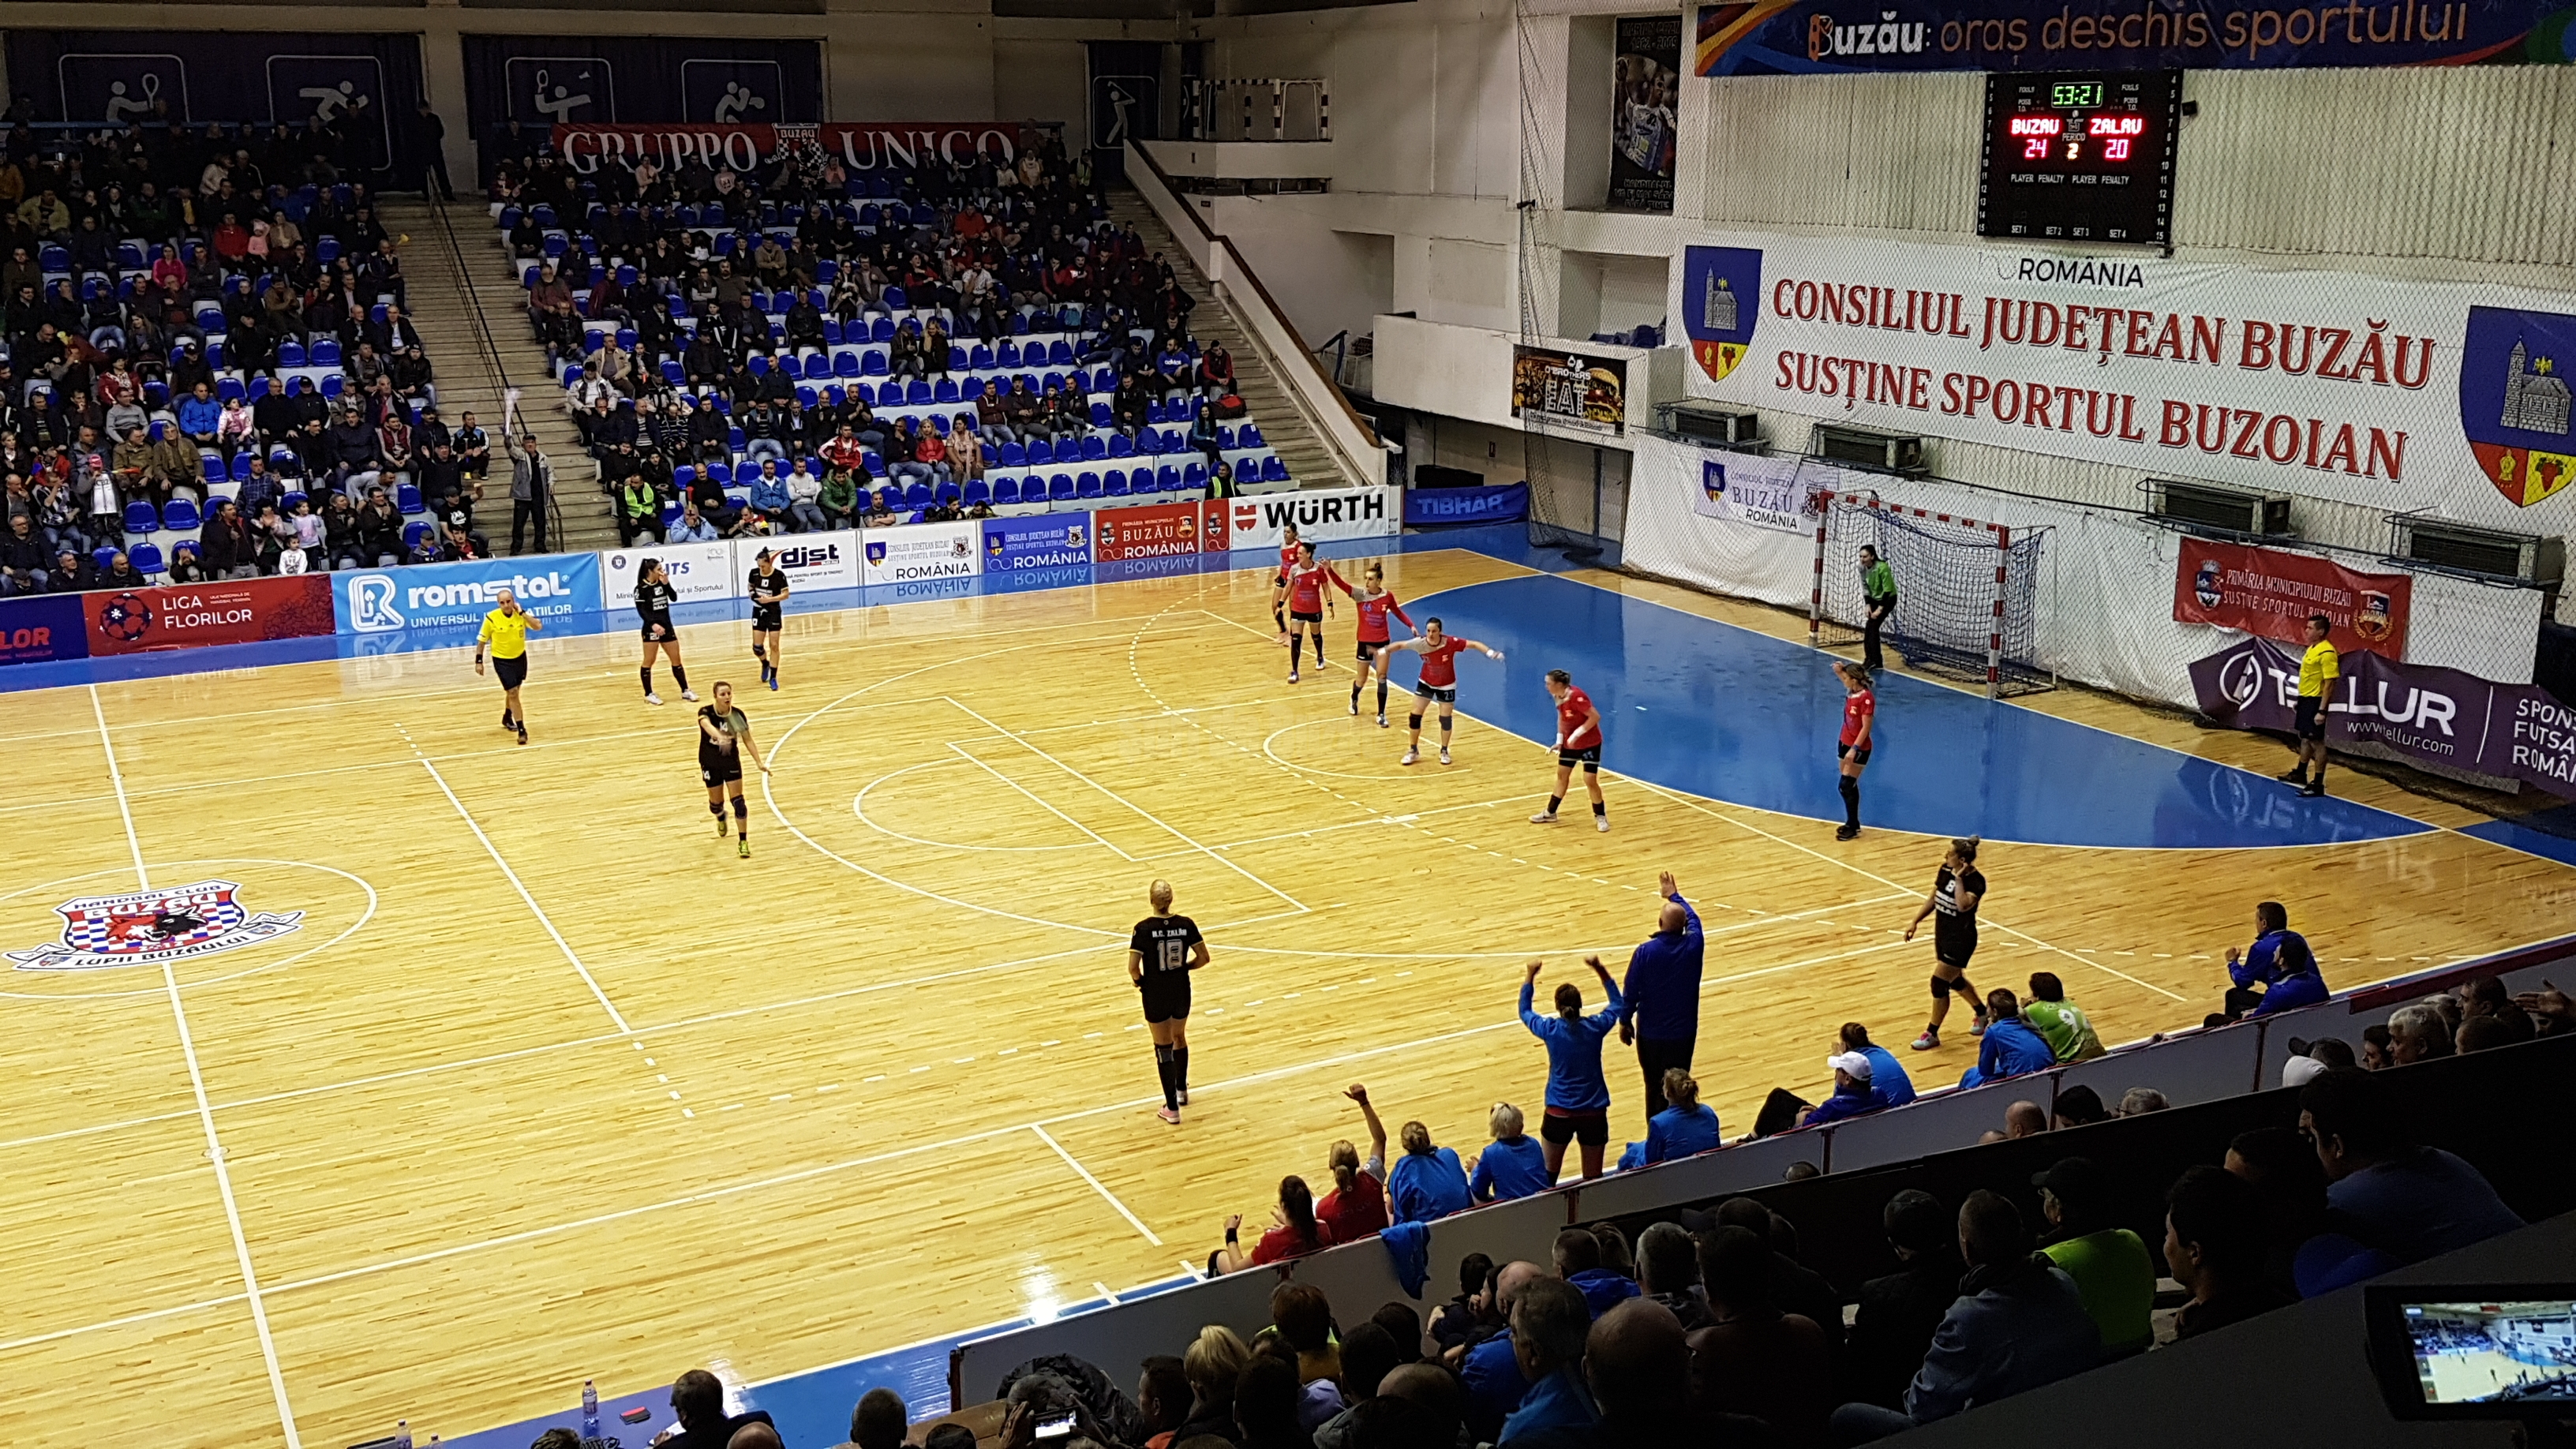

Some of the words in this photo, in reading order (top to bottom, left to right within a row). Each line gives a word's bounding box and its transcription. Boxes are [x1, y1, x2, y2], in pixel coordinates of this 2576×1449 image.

[2042, 4, 2207, 49] deschis
[2225, 0, 2467, 61] sportului
[2053, 85, 2102, 105] 53:21
[2011, 118, 2059, 135] BUZAU
[2090, 118, 2143, 134] ZALAU
[564, 132, 757, 174] GRUPPO
[838, 130, 1013, 170] UNICO
[2025, 139, 2047, 158] 24
[2067, 143, 2079, 159] 2
[2105, 139, 2129, 159] 20
[2011, 174, 2034, 183] PLAYER
[2038, 174, 2065, 184] PENALTY
[2072, 175, 2097, 185] PLAYER
[2102, 176, 2129, 185] PENALTY
[2046, 227, 2057, 235] SET
[2110, 230, 2121, 238] SET
[2018, 256, 2144, 288] ROMÂNIA
[1773, 278, 1970, 339] CONSILIUL
[1979, 296, 2226, 367] JUDEȚEAN
[2238, 317, 2437, 389] BUZĂU
[1545, 380, 1589, 418] EAT
[1775, 350, 1932, 410] SUSȚINE
[1940, 372, 2146, 442] SPORTUL
[2158, 399, 2407, 482] BUZOIAN
[1417, 493, 1504, 515] TIBHAR
[1746, 509, 1799, 530] ROMÂNIA
[1123, 525, 1174, 541] BUZĂU
[1125, 541, 1195, 559] ROMÂNIA
[1013, 551, 1088, 569] ROMÂNIA
[896, 562, 971, 580] ROMÂNIA
[163, 595, 203, 611] LIGA
[2263, 597, 2305, 618] SPORTUL
[164, 608, 253, 629] FLORILOR
[410, 615, 480, 628] UNIVERSUL
[0, 627, 51, 650] LOR
[2347, 721, 2454, 756] wwwtellur.com
[1945, 879, 1956, 893] 8
[74, 893, 167, 909] HANDBAL
[174, 885, 221, 895] CLUB
[75, 956, 132, 966] LUPII
[1157, 939, 1183, 971] 18
